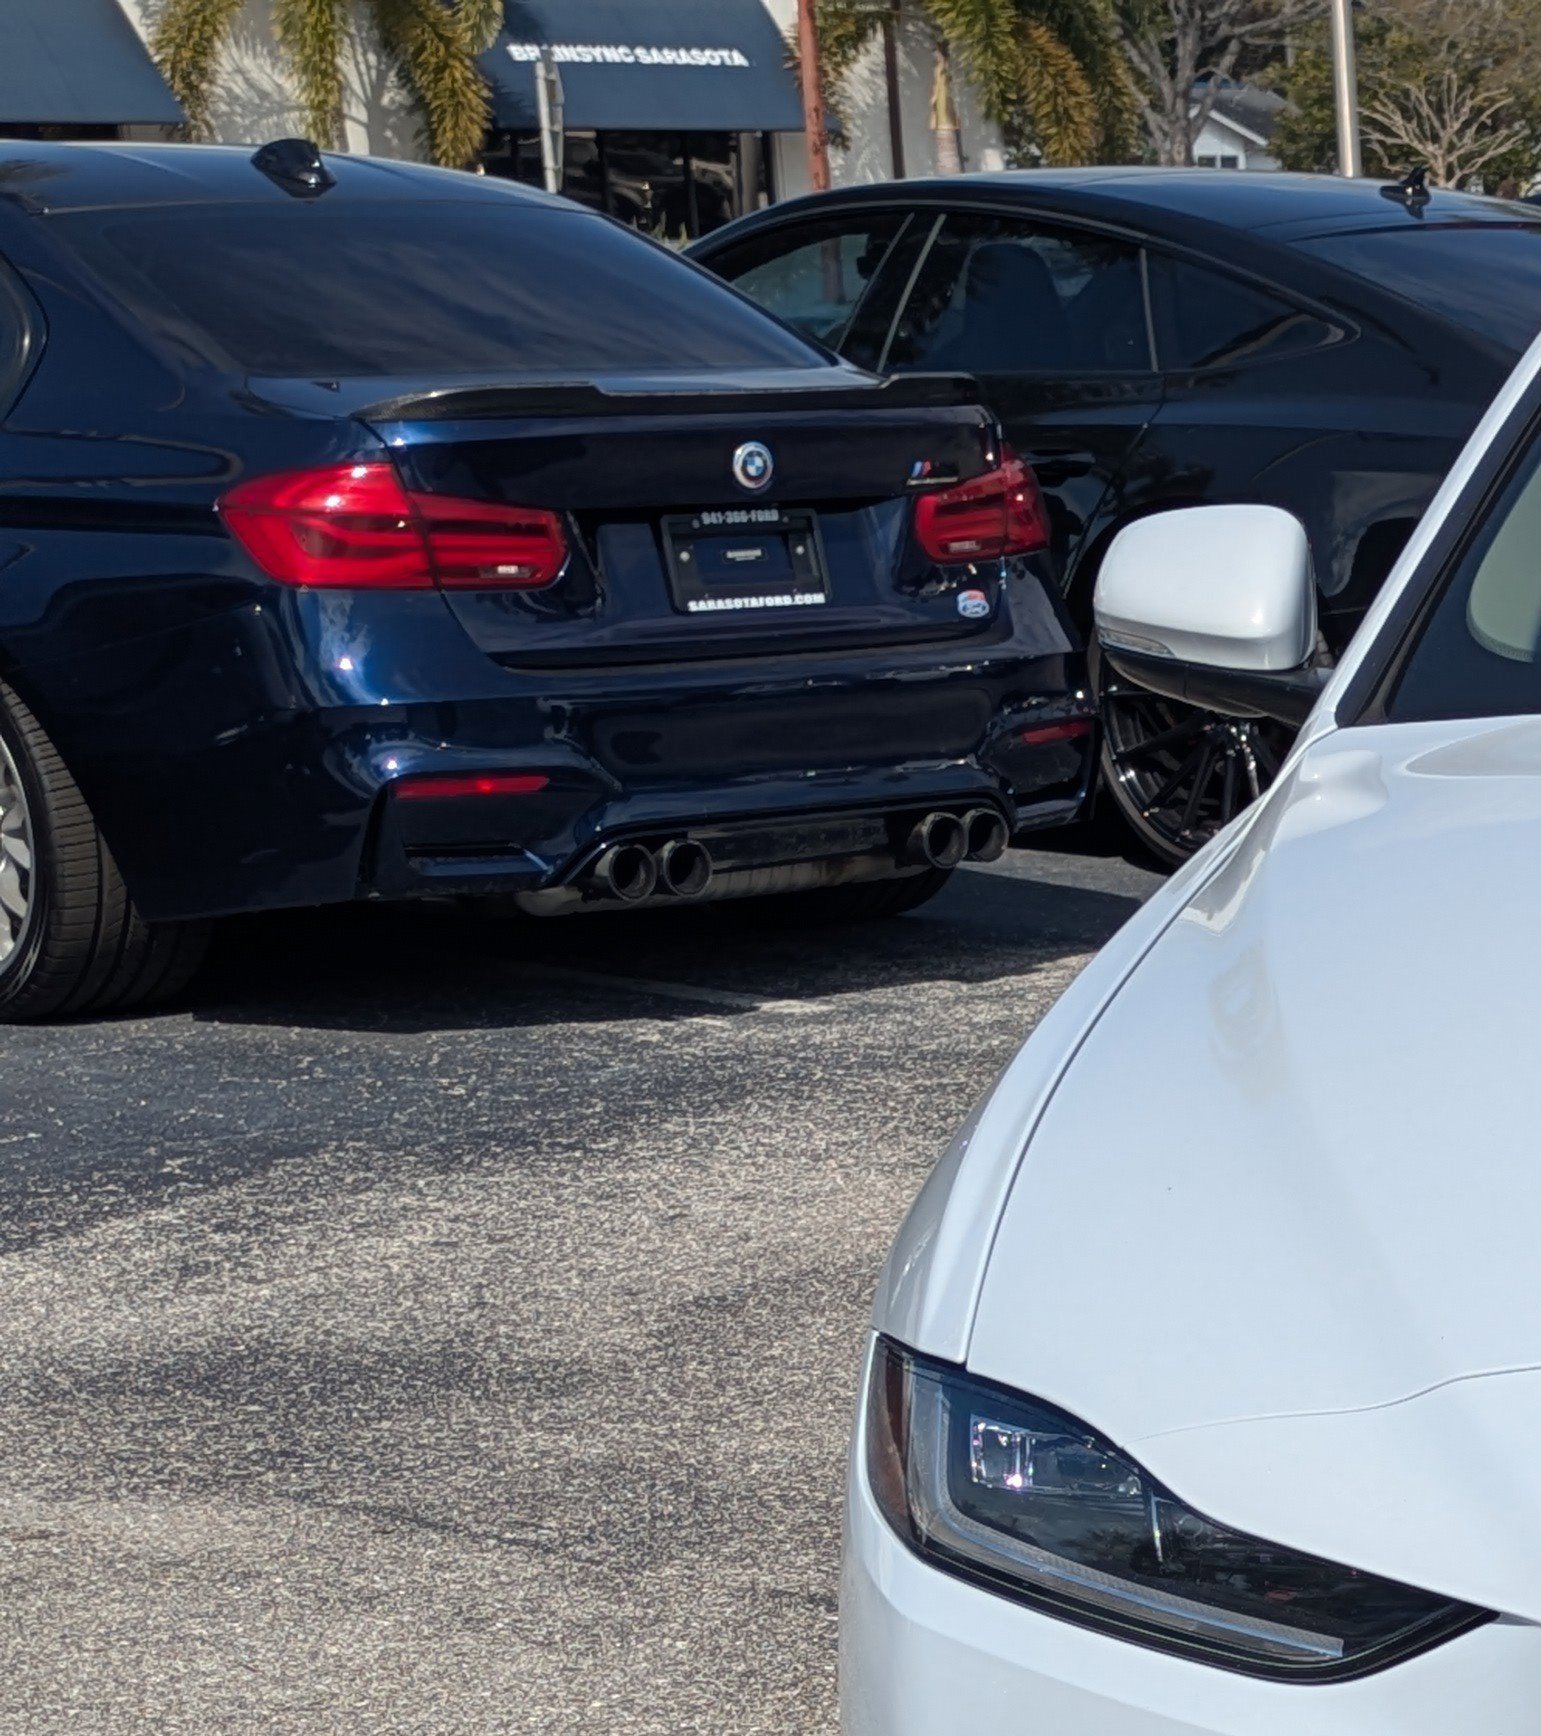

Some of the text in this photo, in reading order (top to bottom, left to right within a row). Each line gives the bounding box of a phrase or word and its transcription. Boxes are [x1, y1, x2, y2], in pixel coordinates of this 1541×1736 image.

[506, 43, 750, 67] BRINSYNC SARASOTA
[687, 592, 826, 612] SARASOTAFORD.COM
